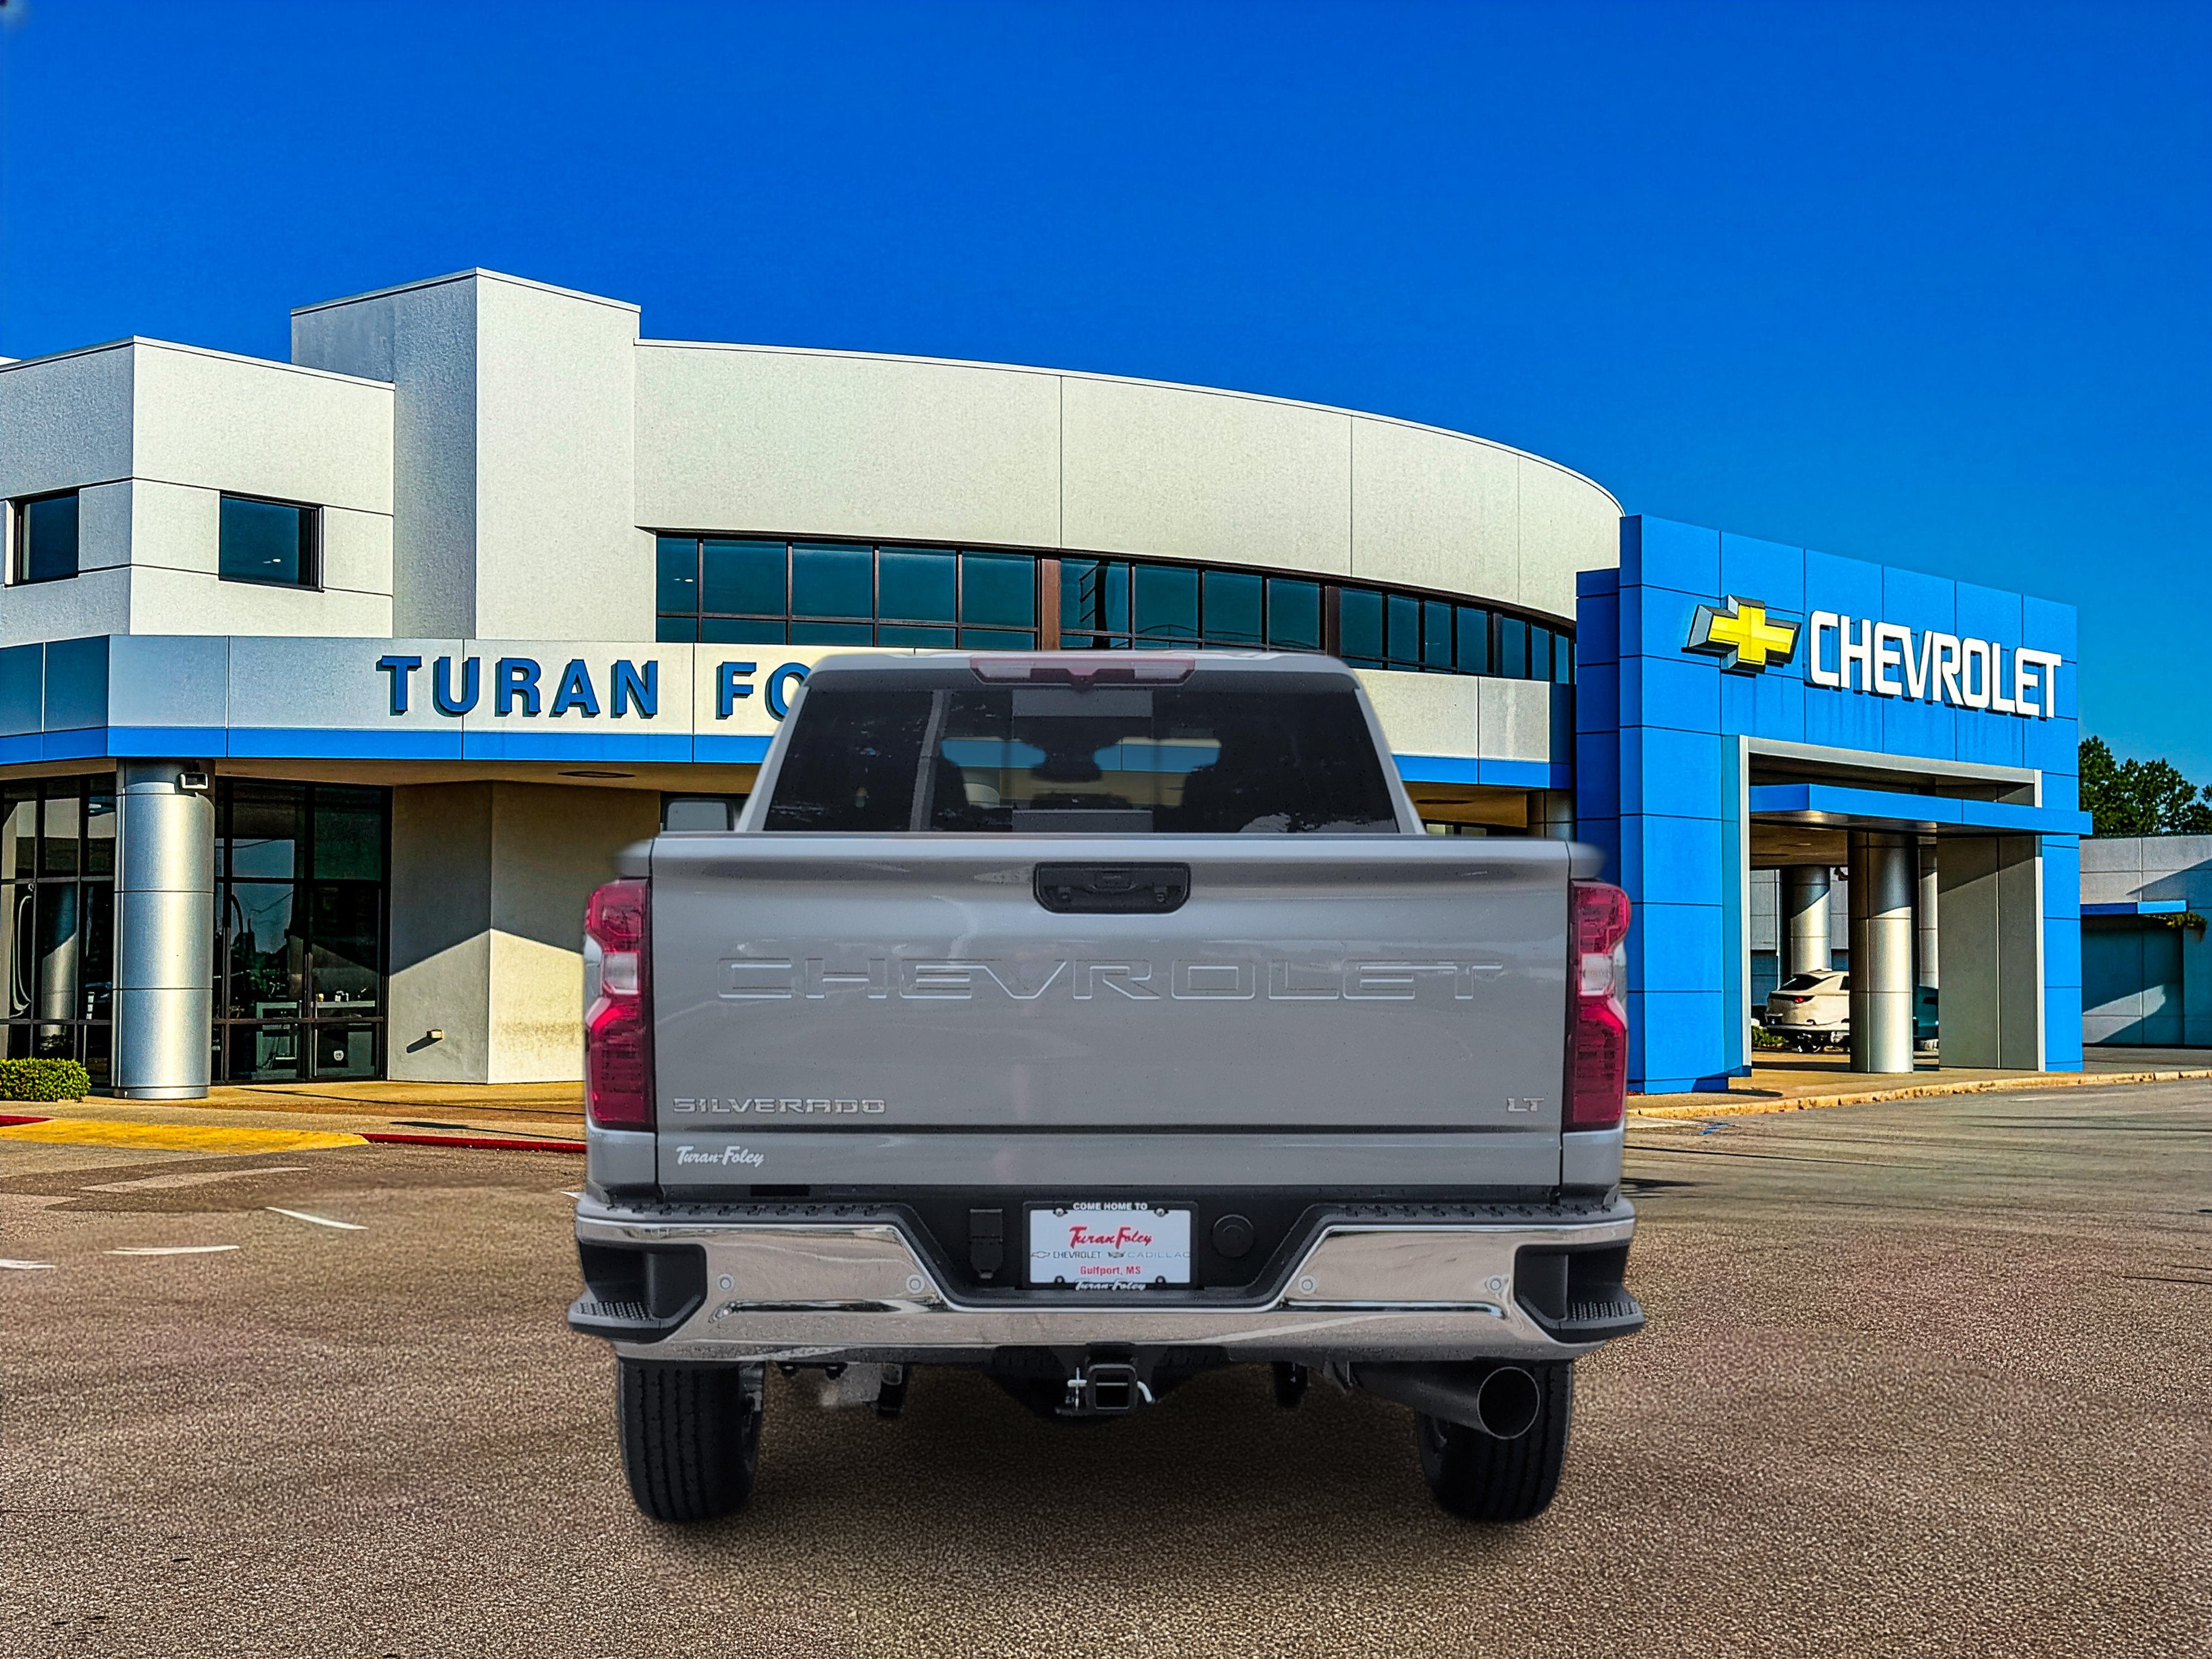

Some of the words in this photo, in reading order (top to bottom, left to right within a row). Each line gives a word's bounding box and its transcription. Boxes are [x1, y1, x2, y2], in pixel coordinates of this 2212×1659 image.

[1809, 609, 2062, 719] CHEVROLET
[376, 655, 659, 719] TURAN
[717, 957, 1504, 1000] CHEVROLET
[673, 1098, 886, 1114] SILVERADO
[1507, 1097, 1545, 1112] LT
[676, 1145, 764, 1167] Turan-Foley
[1073, 1202, 1101, 1211] COME
[1104, 1202, 1134, 1211] HOME
[1136, 1202, 1148, 1211] TO
[1126, 1265, 1141, 1275] MS
